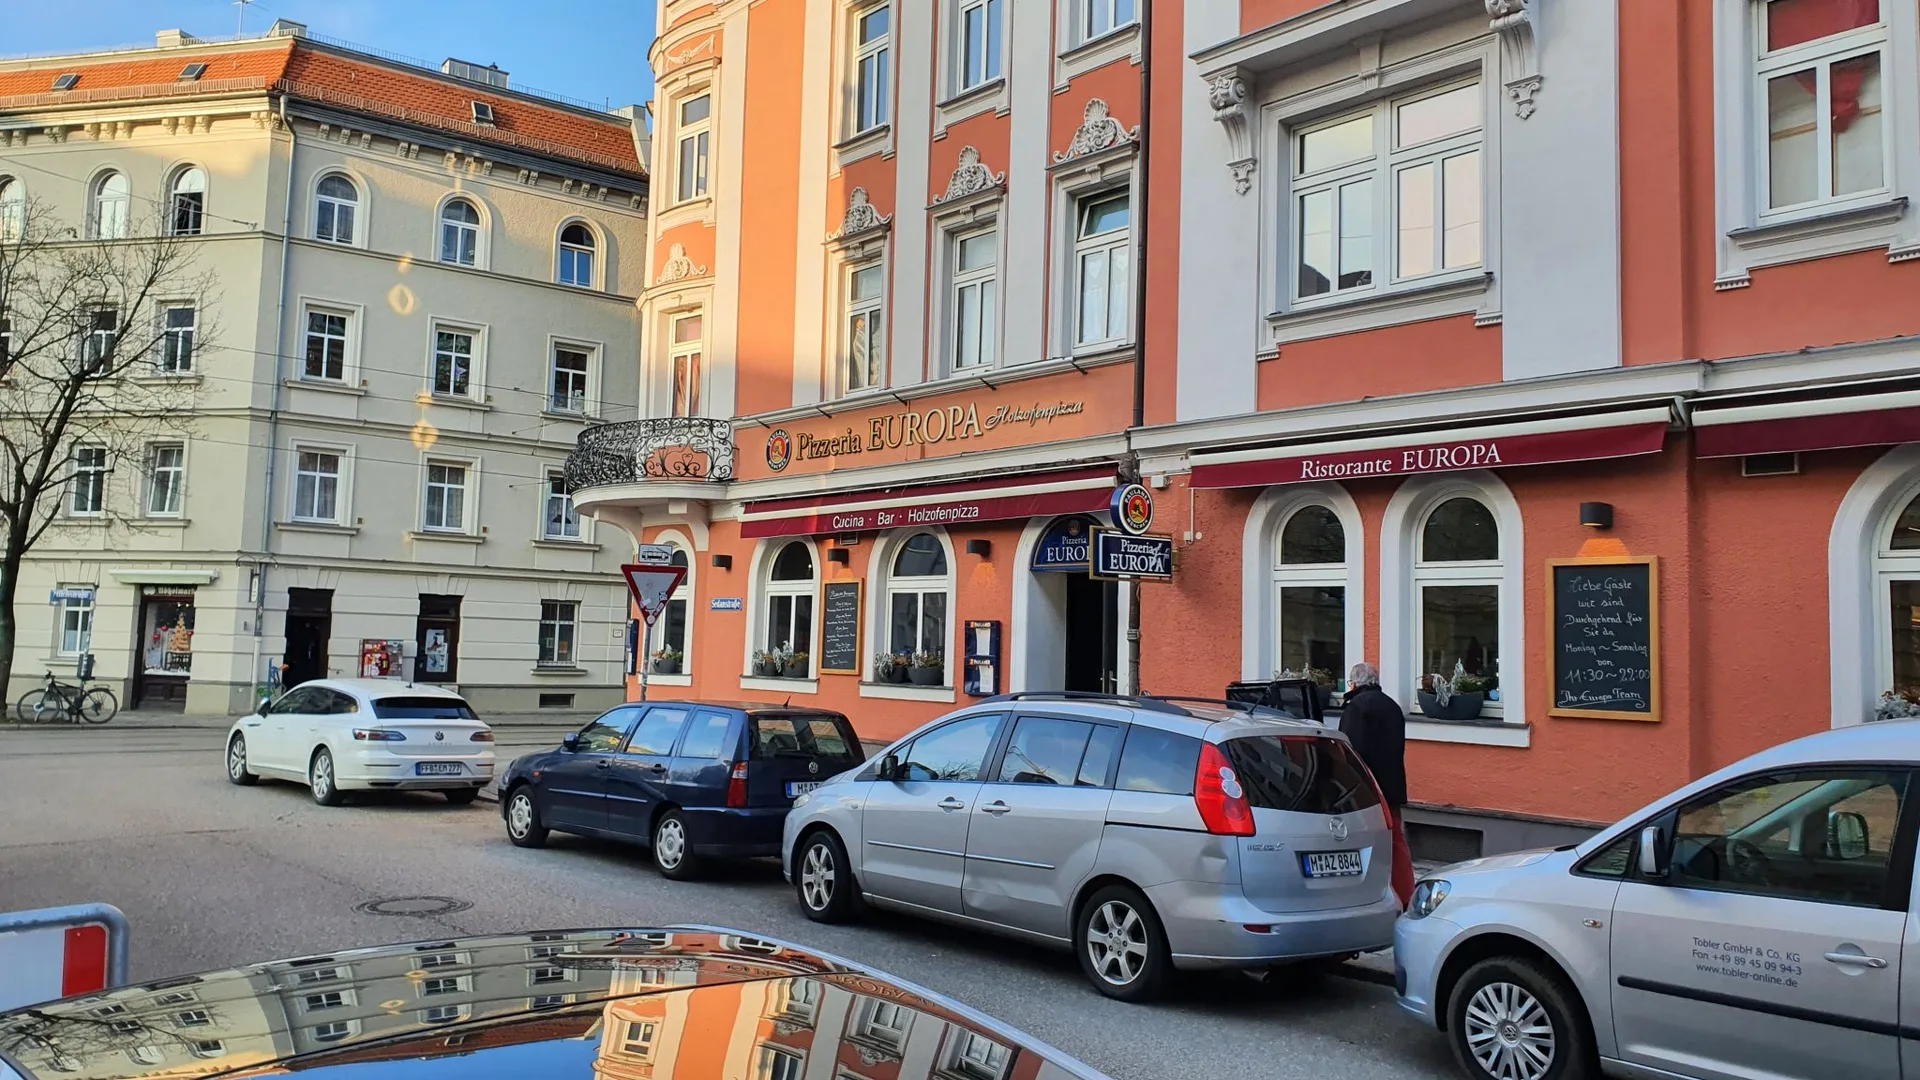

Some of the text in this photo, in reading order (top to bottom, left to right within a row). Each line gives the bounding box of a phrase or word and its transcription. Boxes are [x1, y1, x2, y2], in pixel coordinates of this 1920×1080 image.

[796, 400, 1085, 461] Pizzeria EUROPA Holzofenpizza
[1300, 443, 1503, 479] Ristorante EUROPA
[832, 504, 979, 529] Cucina Bar Holzofenpizza
[1062, 536, 1087, 545] Pizzeria
[1121, 539, 1154, 553] Pizzeria
[1110, 553, 1165, 573] EUROPA
[1568, 576, 1602, 593] Liebe
[1601, 597, 1625, 607] sind
[1563, 612, 1643, 628] Durchgehend für
[1583, 627, 1615, 637] Sie da
[1612, 640, 1648, 657] Sonntag
[1580, 691, 1612, 704] Europa
[1612, 688, 1642, 699] Team
[1311, 853, 1360, 871] M AZ 8844
[1693, 937, 1800, 962] Tobler GmbH & Co. KG
[1692, 949, 1802, 975] Fon +49 89 45 09 94-3
[1696, 963, 1798, 987] www.tobler-online.de
